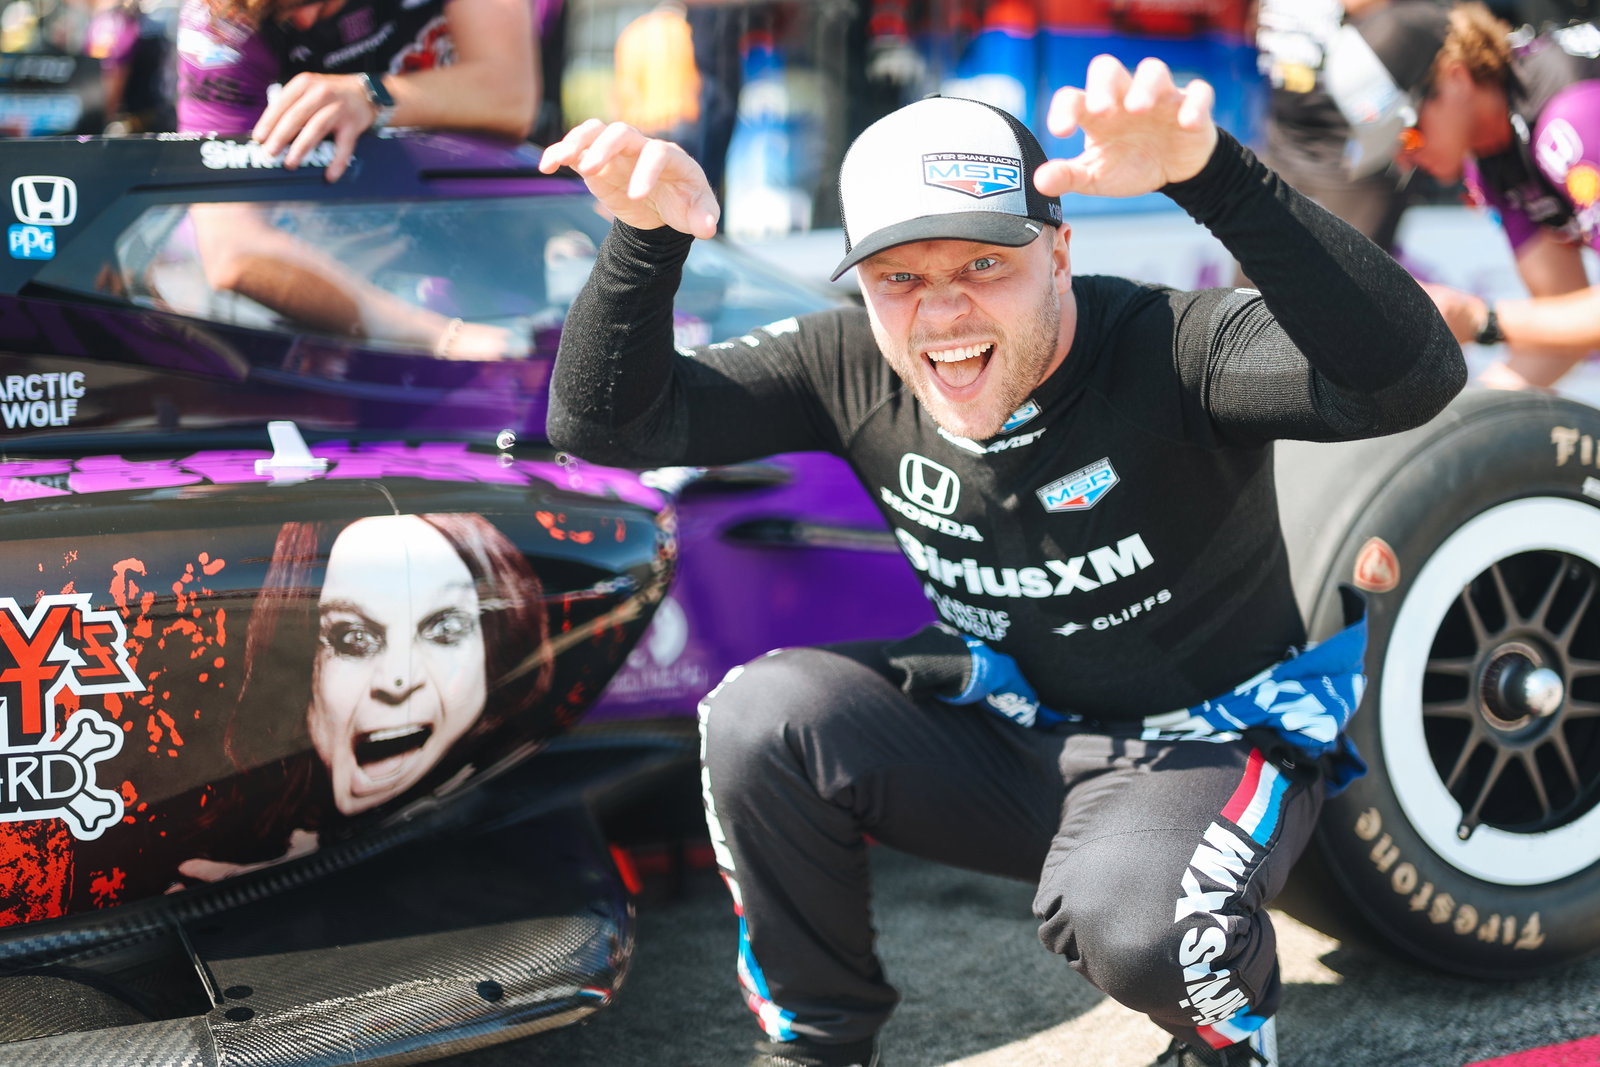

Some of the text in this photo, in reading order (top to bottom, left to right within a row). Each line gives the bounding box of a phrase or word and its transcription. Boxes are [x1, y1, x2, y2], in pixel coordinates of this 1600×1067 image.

[928, 163, 1019, 185] MSR
[957, 154, 989, 163] SHANK
[989, 157, 1021, 167] RACING
[10, 226, 54, 257] PPG
[0, 398, 78, 429] WOLF
[1046, 469, 1113, 505] MSR
[880, 486, 984, 542] HONDA
[895, 533, 1154, 597] SiriusXM
[1092, 589, 1172, 631] CLIFFS
